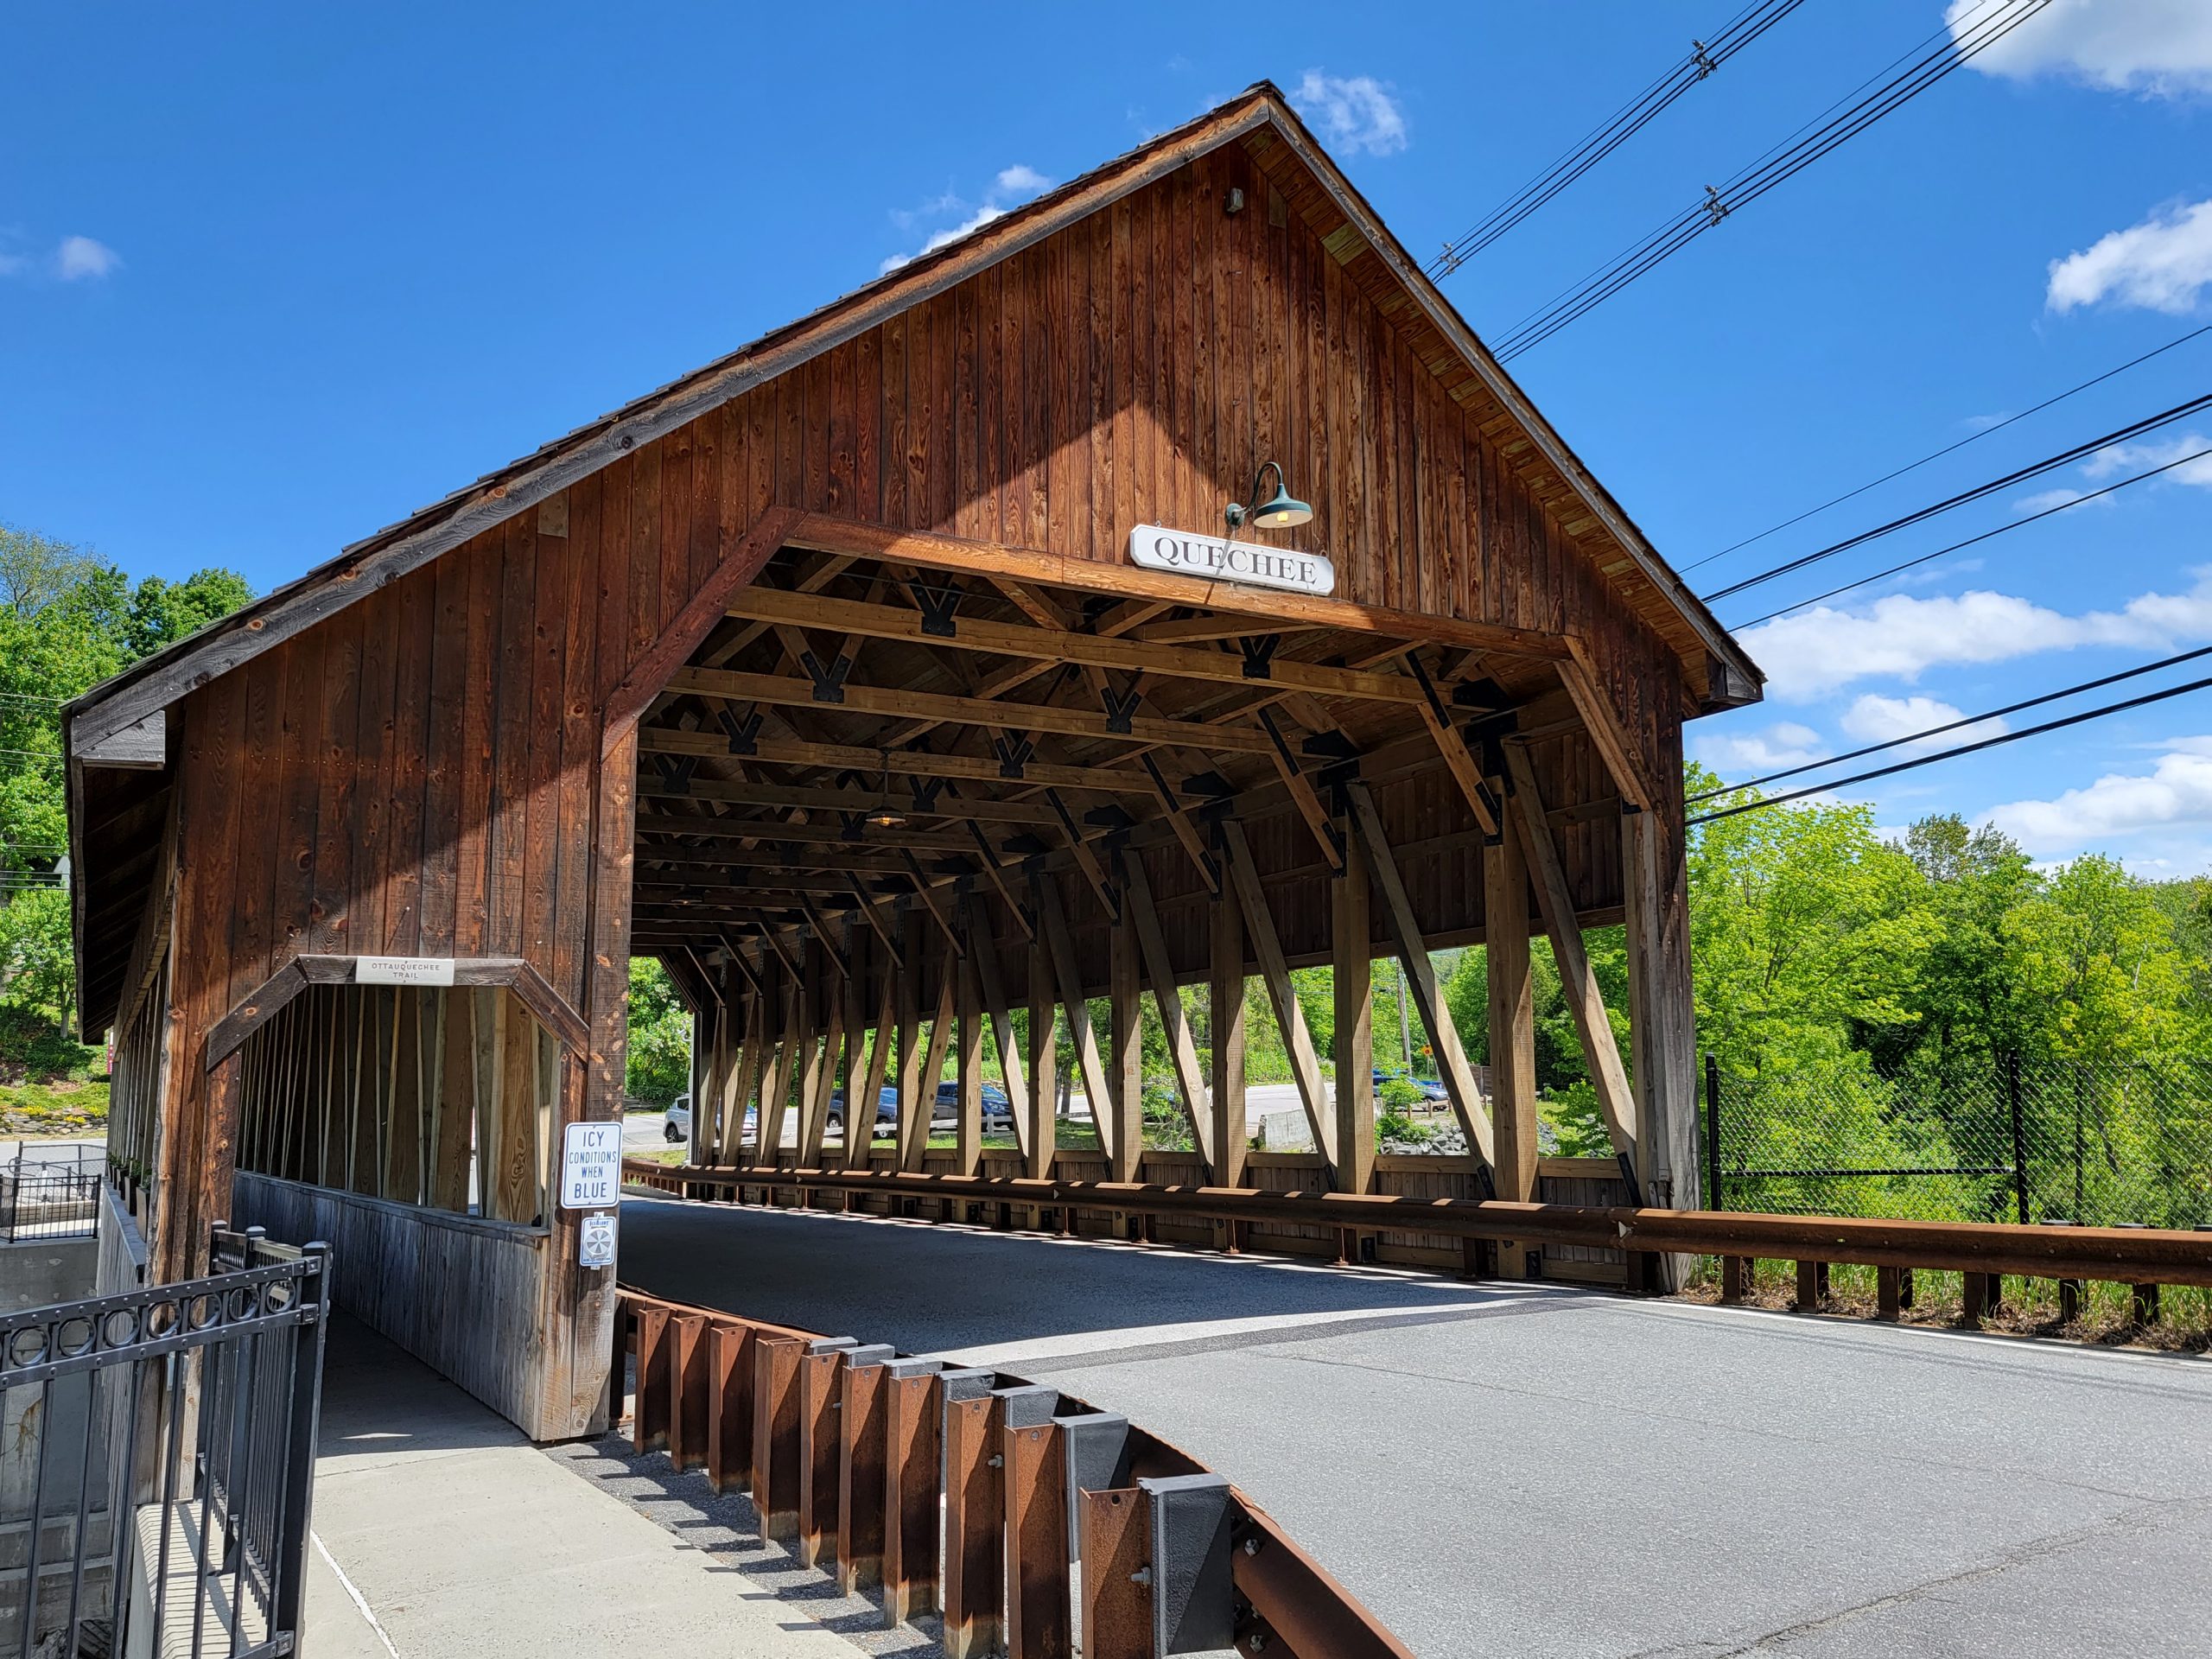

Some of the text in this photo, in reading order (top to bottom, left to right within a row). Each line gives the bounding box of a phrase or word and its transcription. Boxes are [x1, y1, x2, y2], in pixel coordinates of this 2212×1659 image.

[1154, 537, 1318, 585] QUECHEE
[582, 1131, 605, 1147] ICY
[569, 1151, 617, 1164] CONDITIONS
[581, 1166, 603, 1179] WHEN
[574, 1182, 607, 1198] BLUE
